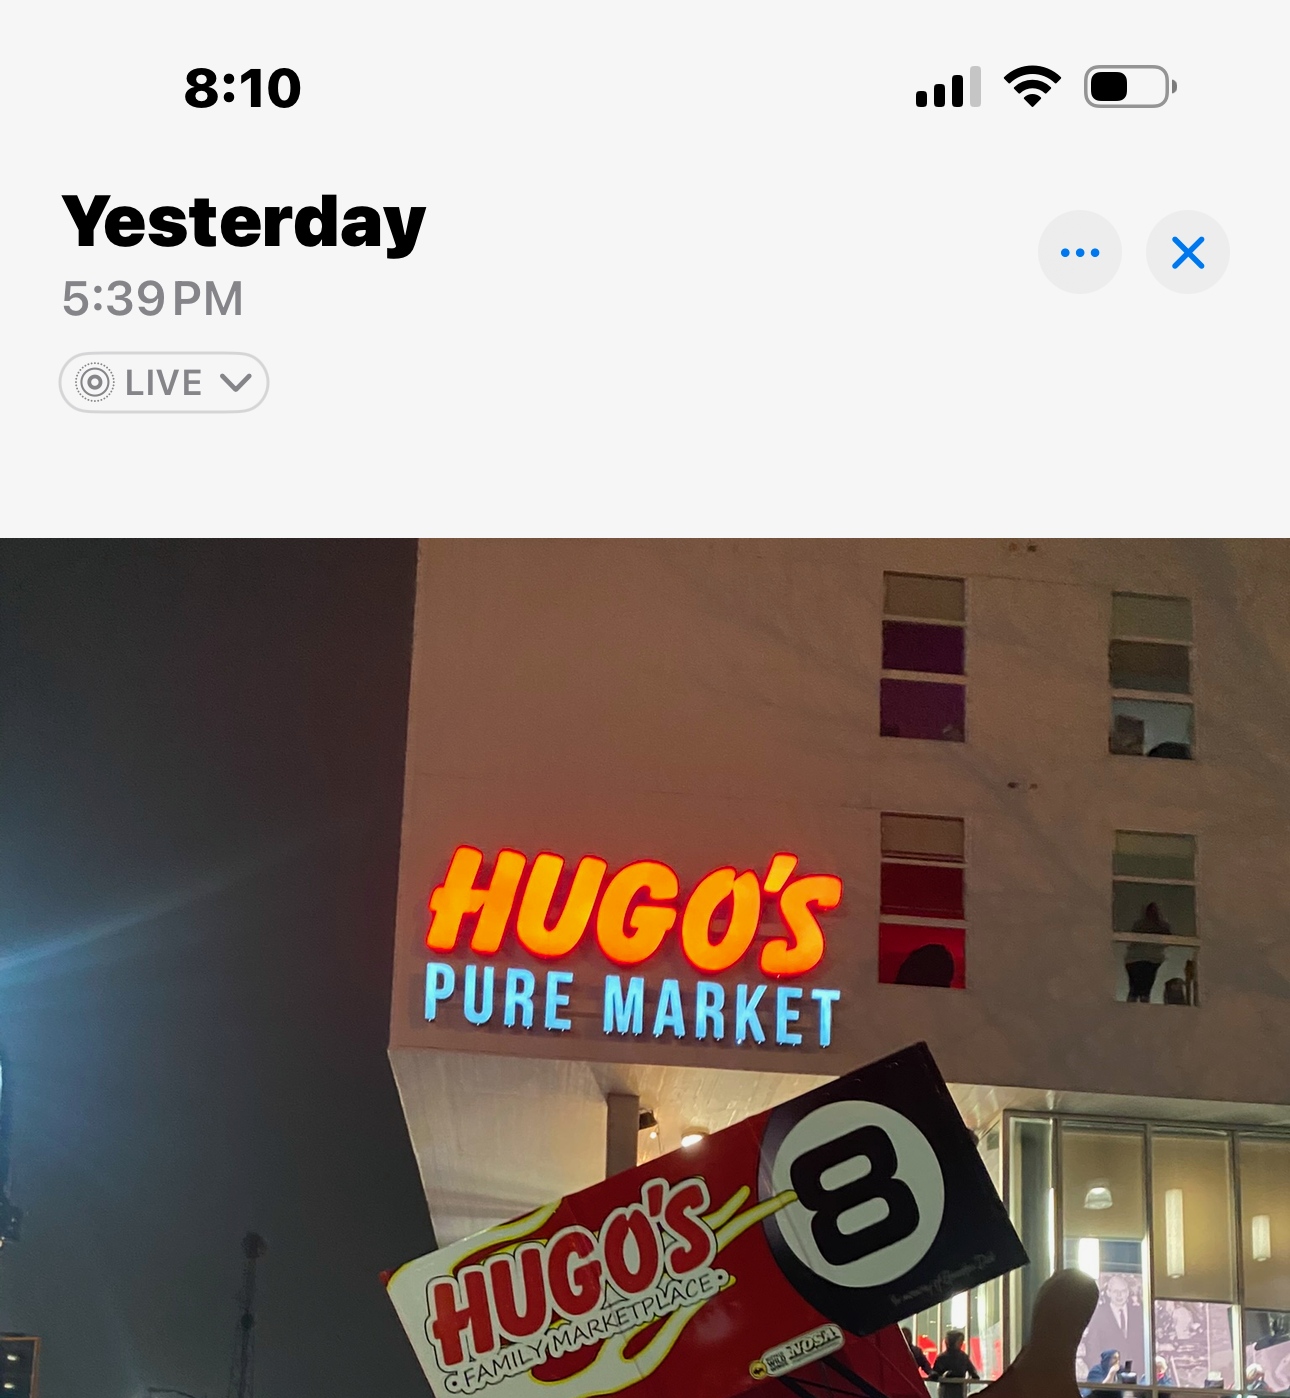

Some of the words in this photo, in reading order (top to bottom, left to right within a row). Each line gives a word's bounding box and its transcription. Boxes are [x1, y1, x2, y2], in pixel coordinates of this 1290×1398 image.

[425, 844, 843, 977] HUGO'S
[424, 962, 574, 1031] PURE
[603, 976, 841, 1048] MARKET
[790, 1125, 920, 1266] 8
[432, 1180, 715, 1365] HUGO'S
[463, 1340, 543, 1387] FAMILY
[552, 1275, 713, 1350] MARKETPLACE
